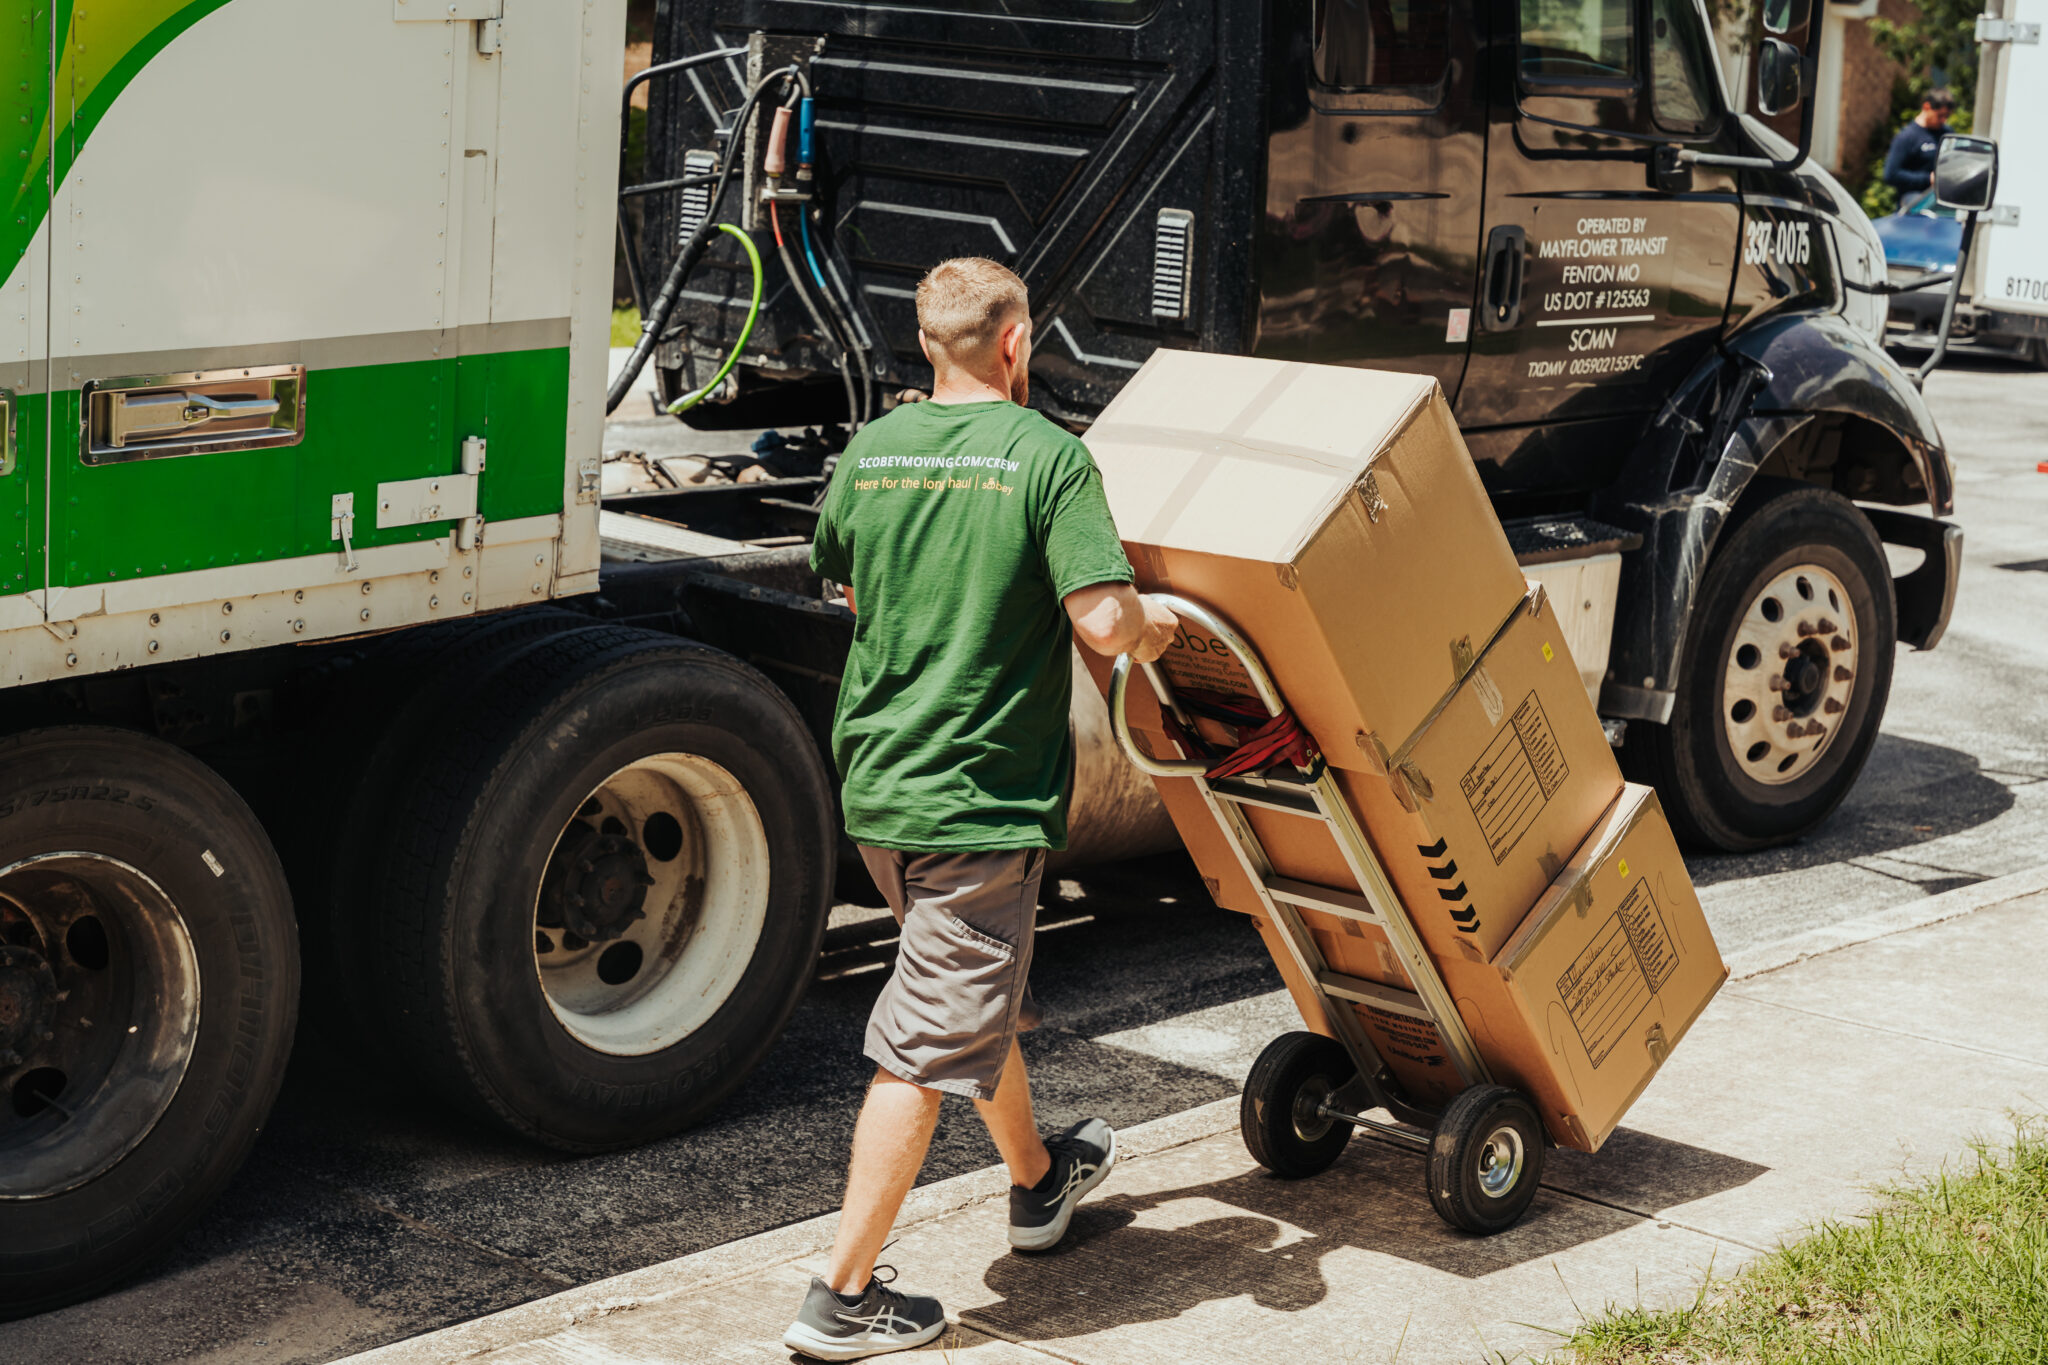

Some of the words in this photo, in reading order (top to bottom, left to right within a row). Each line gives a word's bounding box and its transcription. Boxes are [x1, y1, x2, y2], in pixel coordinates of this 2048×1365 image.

[1577, 217, 1631, 235] OPERATED
[1632, 217, 1648, 234] BY
[1539, 238, 1618, 258] MAYFLOWER
[1620, 236, 1668, 256] TRANSIT
[1562, 264, 1615, 284] FENTON
[1616, 263, 1640, 282] MO
[1544, 292, 1562, 312] US
[1564, 291, 1594, 311] DOT
[1595, 288, 1651, 309] #125563
[1568, 327, 1618, 352] SCMN
[1528, 360, 1567, 378] TXDMV
[858, 455, 1020, 472] SCOBEYMOVINGCOM/CREW
[855, 478, 879, 492] Here
[881, 476, 899, 489] for
[901, 476, 920, 489] the
[923, 476, 946, 492] long
[947, 475, 972, 489] haul
